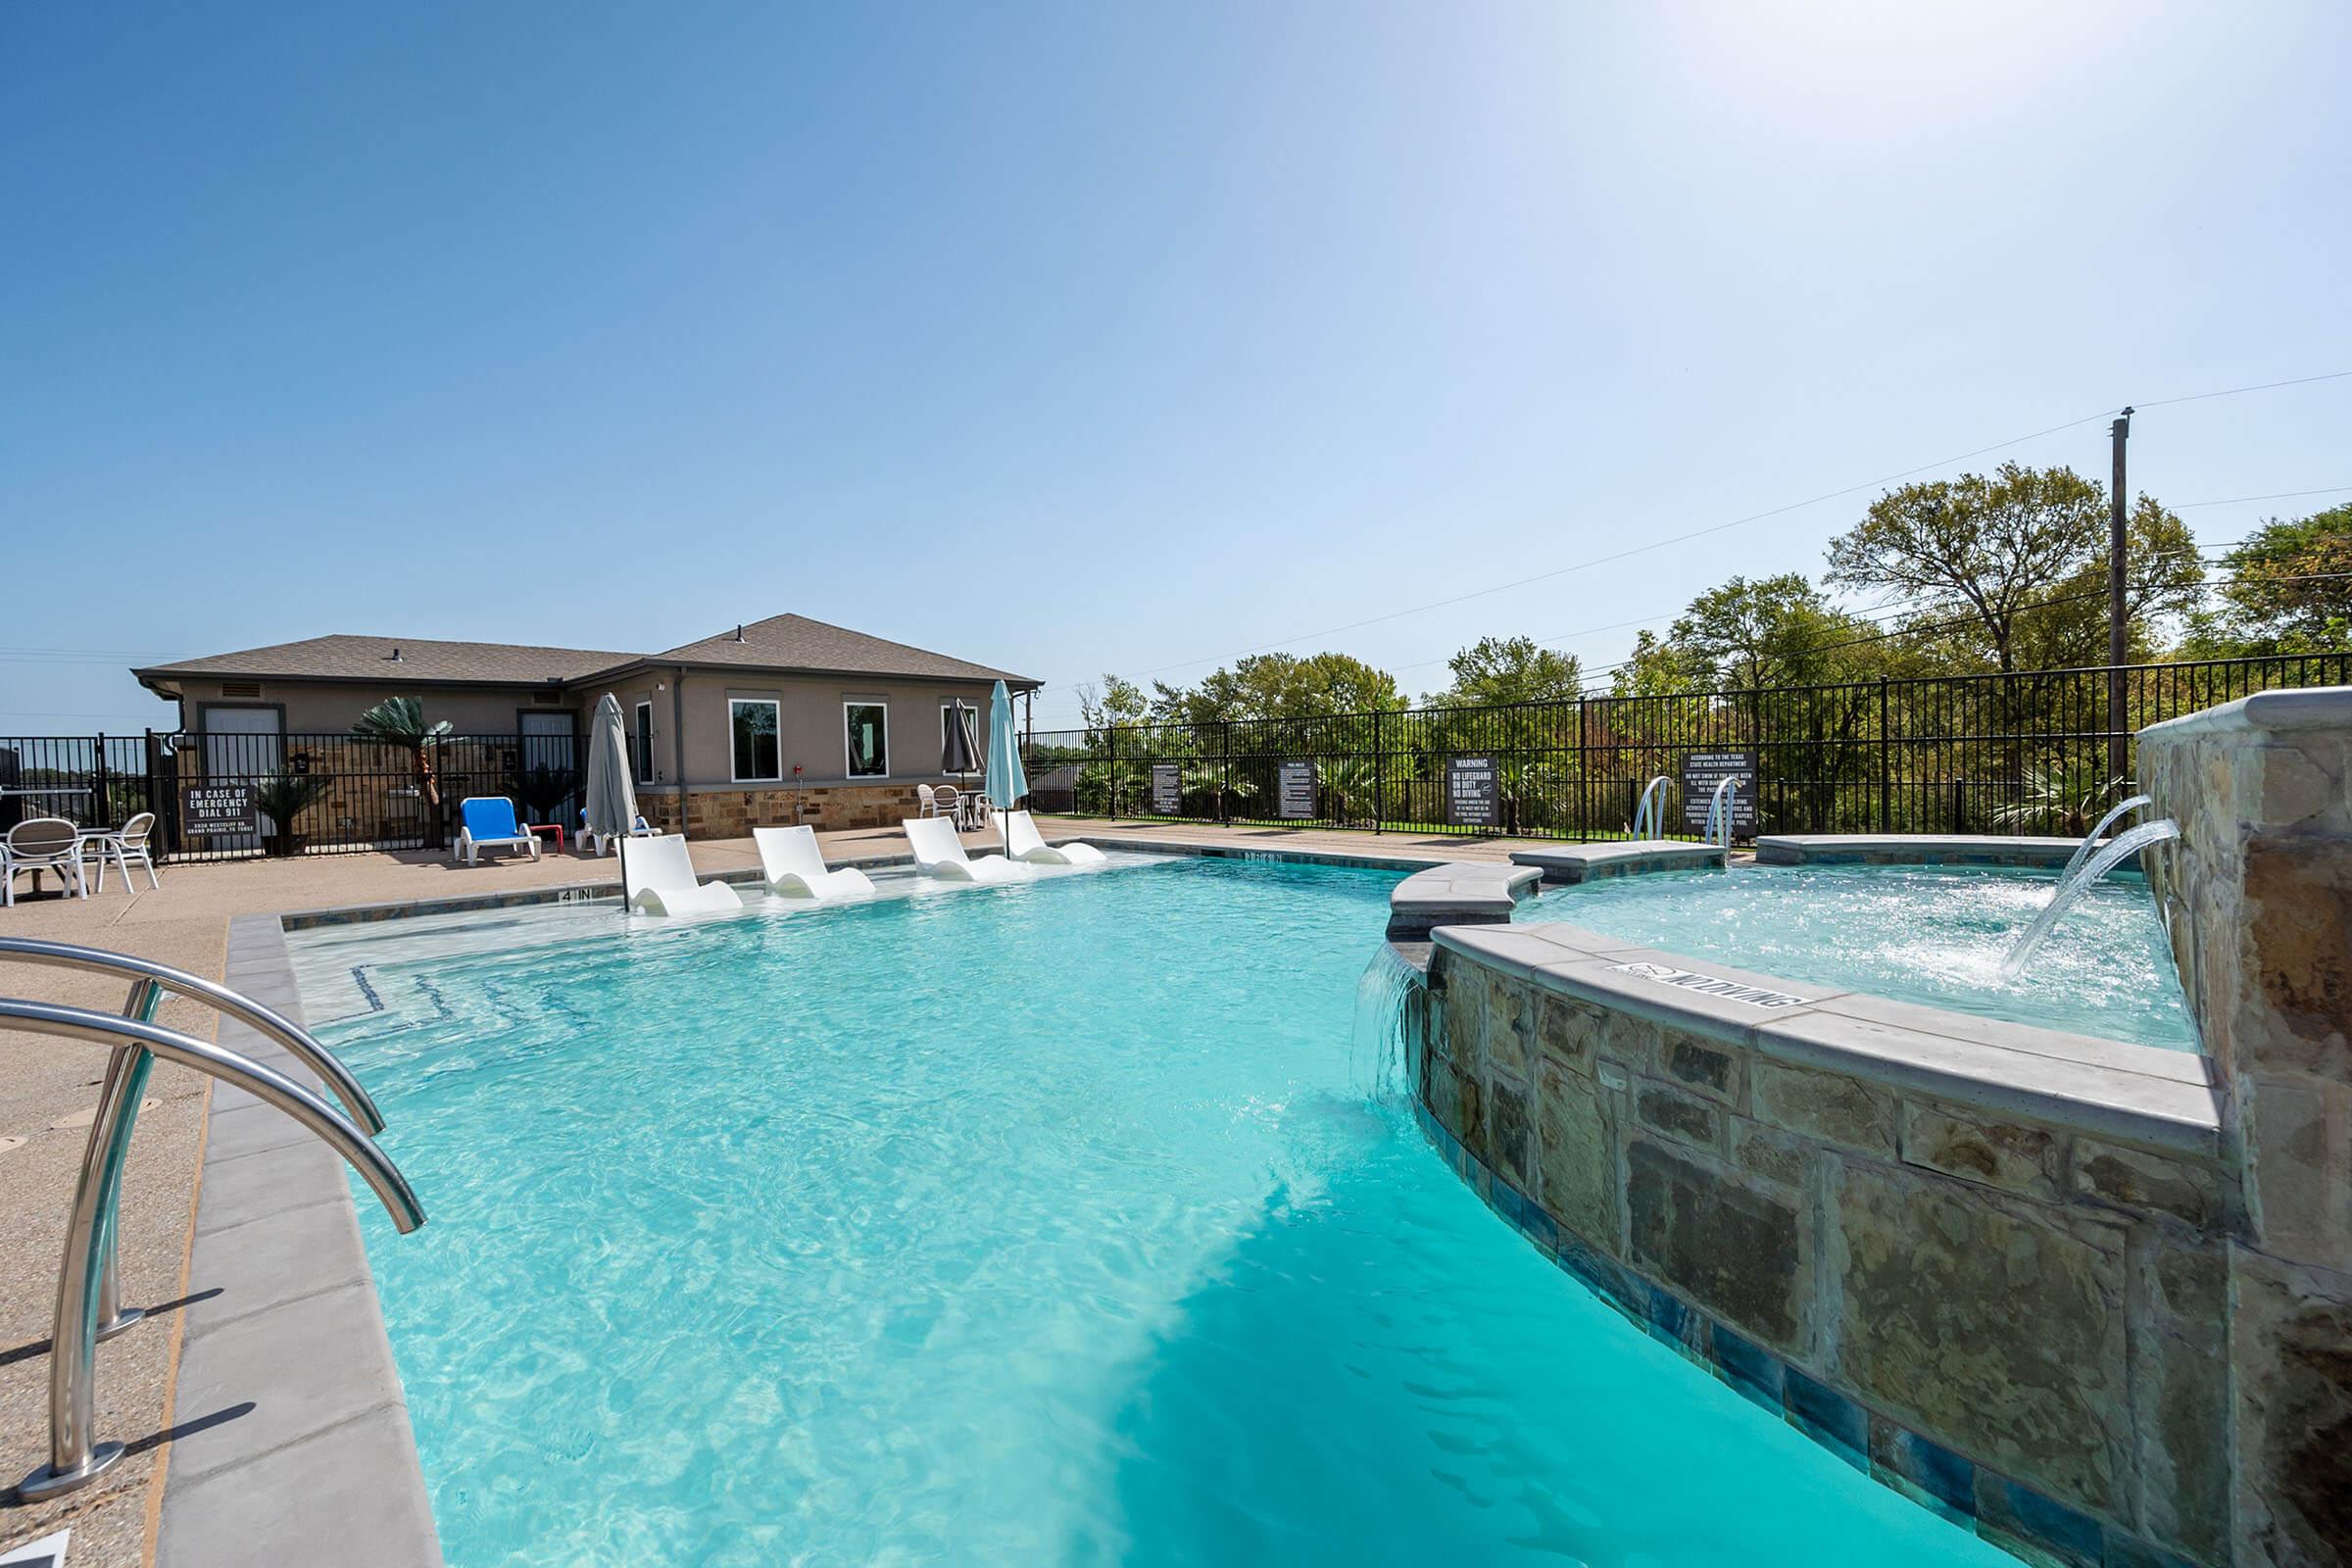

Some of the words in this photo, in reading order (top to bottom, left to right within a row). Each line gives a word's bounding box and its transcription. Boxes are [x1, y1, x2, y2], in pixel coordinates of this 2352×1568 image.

[1455, 760, 1488, 768] WARNING
[190, 790, 201, 799] IN
[206, 790, 230, 799] CASE
[235, 789, 246, 798] OF
[190, 799, 248, 808] EMERGENCY
[199, 808, 221, 817] DIAL
[1265, 854, 1270, 862] 6
[563, 891, 571, 901] 4
[578, 889, 590, 900] IN
[1666, 973, 1714, 990] NO
[1707, 983, 1802, 1007] DIVING
